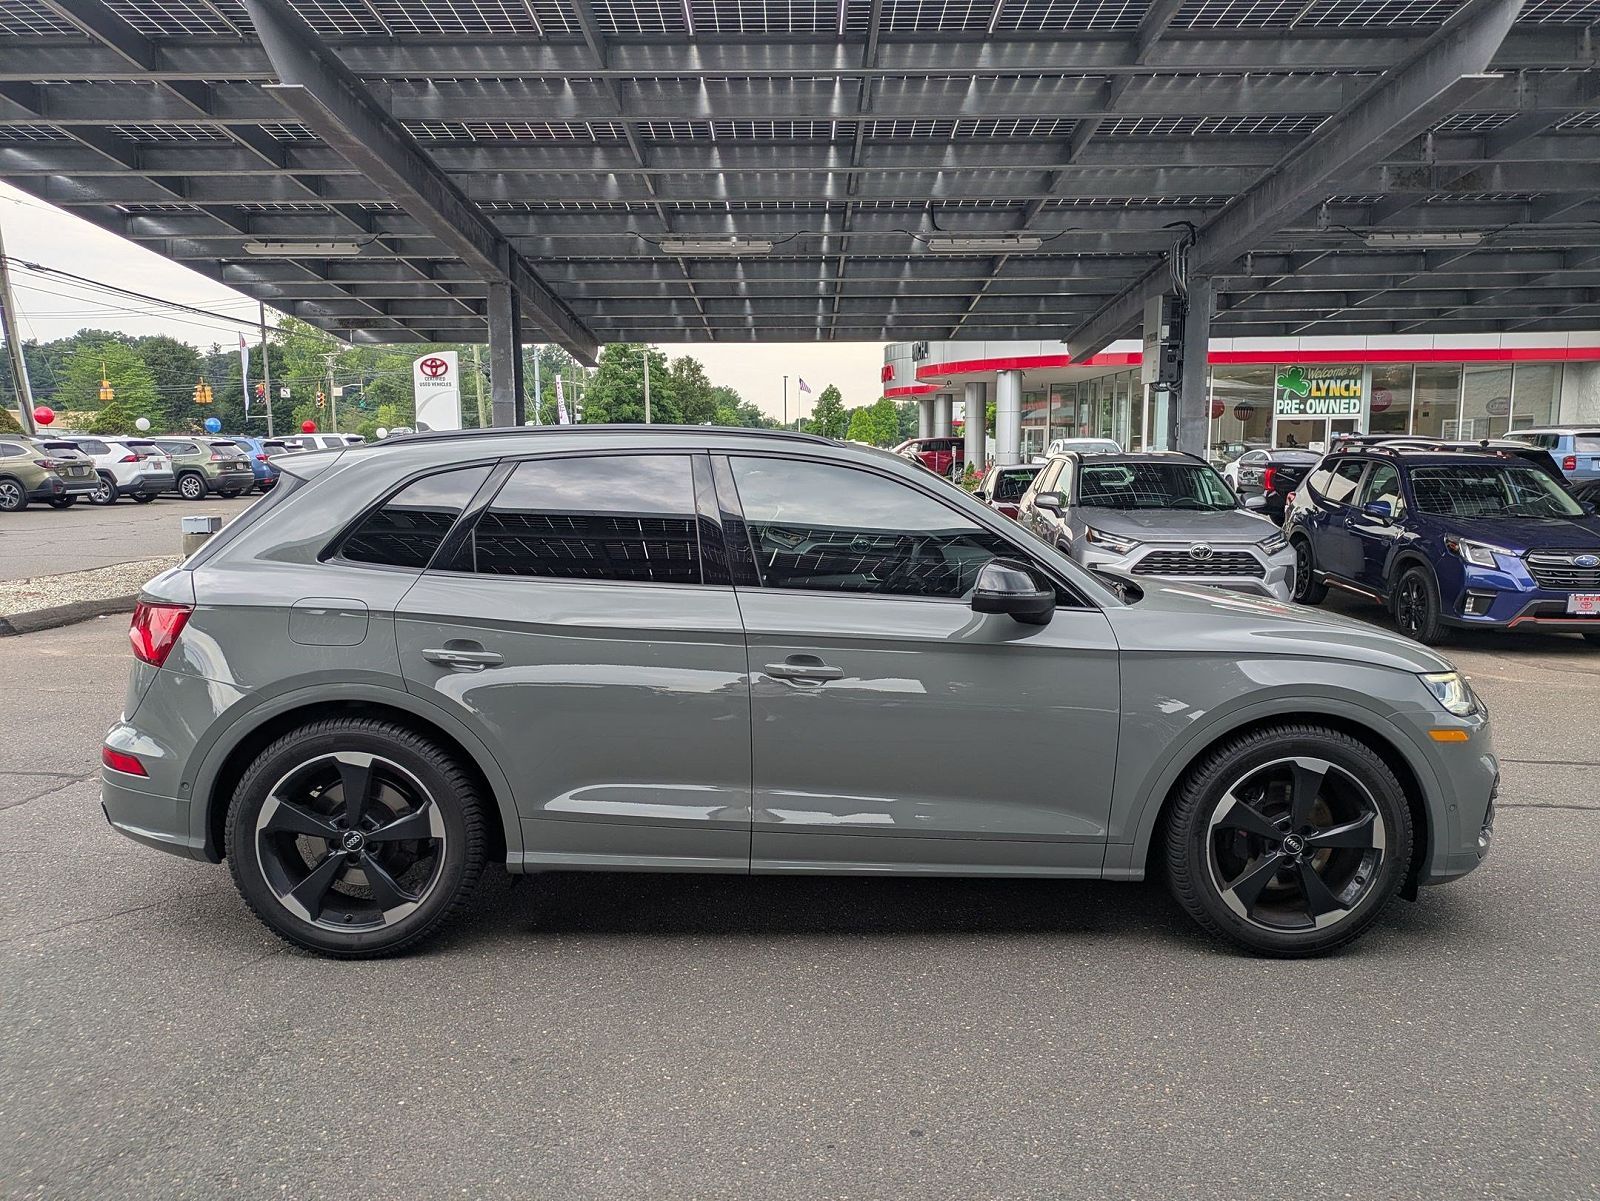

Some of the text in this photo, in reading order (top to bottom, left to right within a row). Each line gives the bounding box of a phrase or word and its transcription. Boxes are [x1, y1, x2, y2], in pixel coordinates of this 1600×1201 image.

[1308, 365, 1360, 379] Welcome to
[1311, 379, 1361, 397] LYNCH
